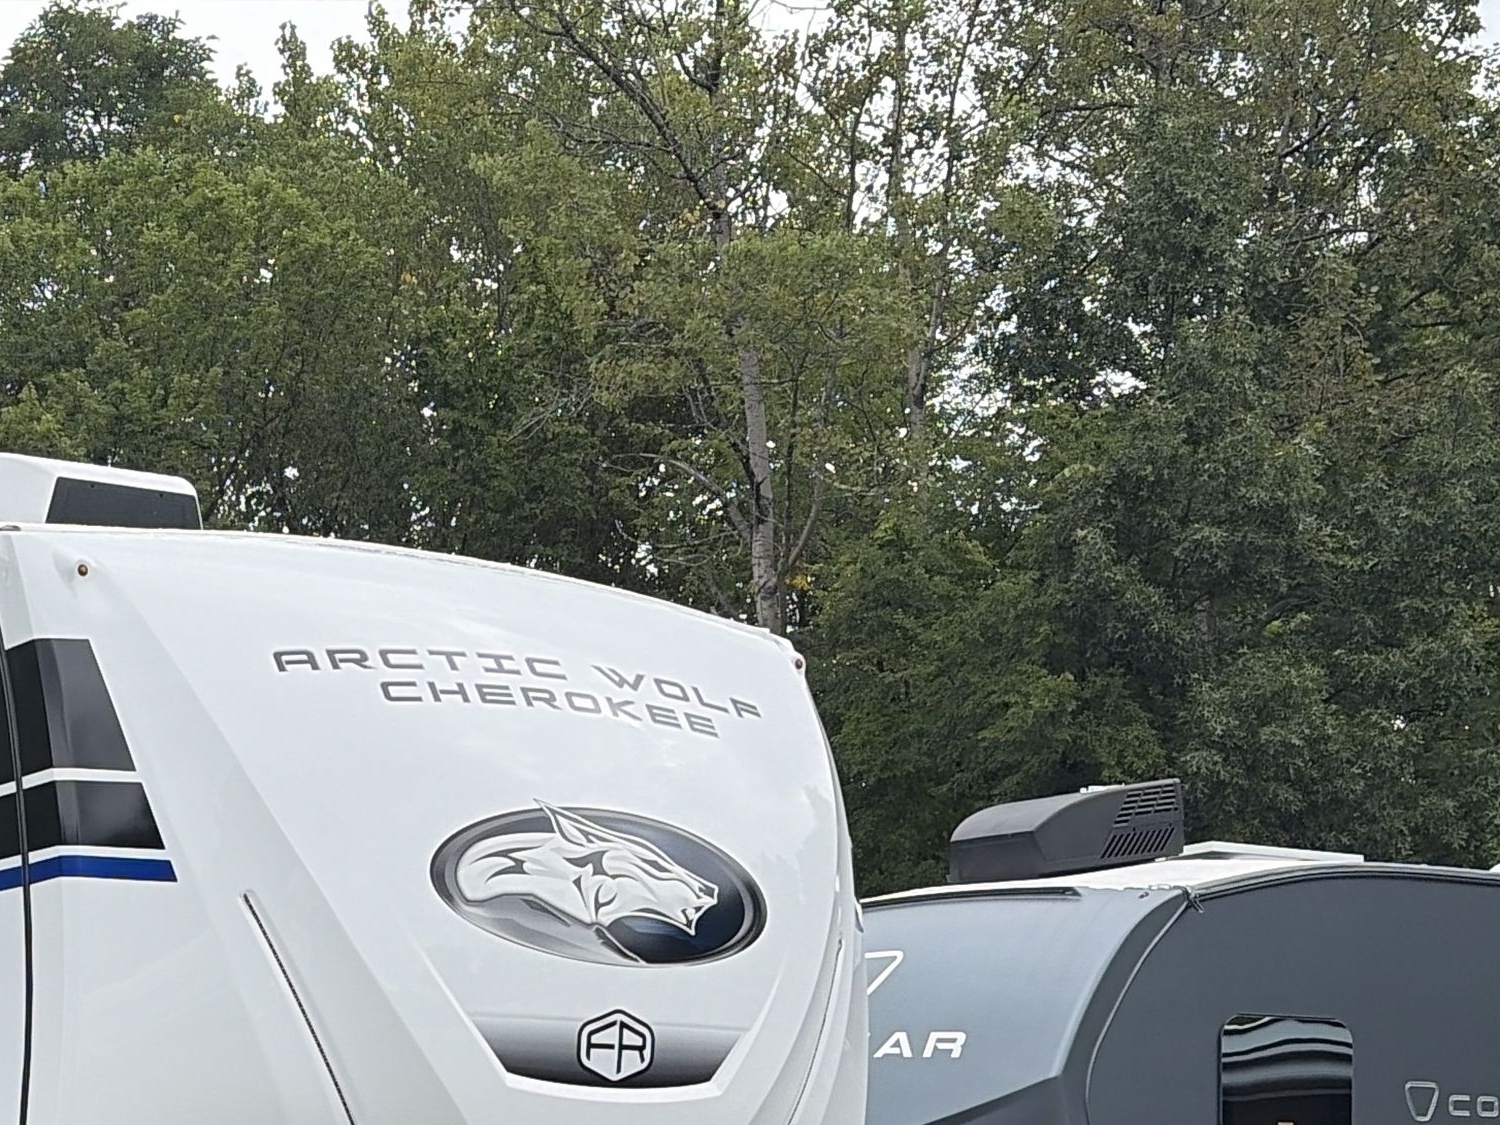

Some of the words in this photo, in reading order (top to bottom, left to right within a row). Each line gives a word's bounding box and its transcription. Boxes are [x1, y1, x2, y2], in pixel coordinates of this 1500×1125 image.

[272, 648, 568, 681] ARCTIC
[590, 664, 763, 719] WOLF
[379, 680, 721, 739] CHEROKEE
[867, 1030, 967, 1058] AR
